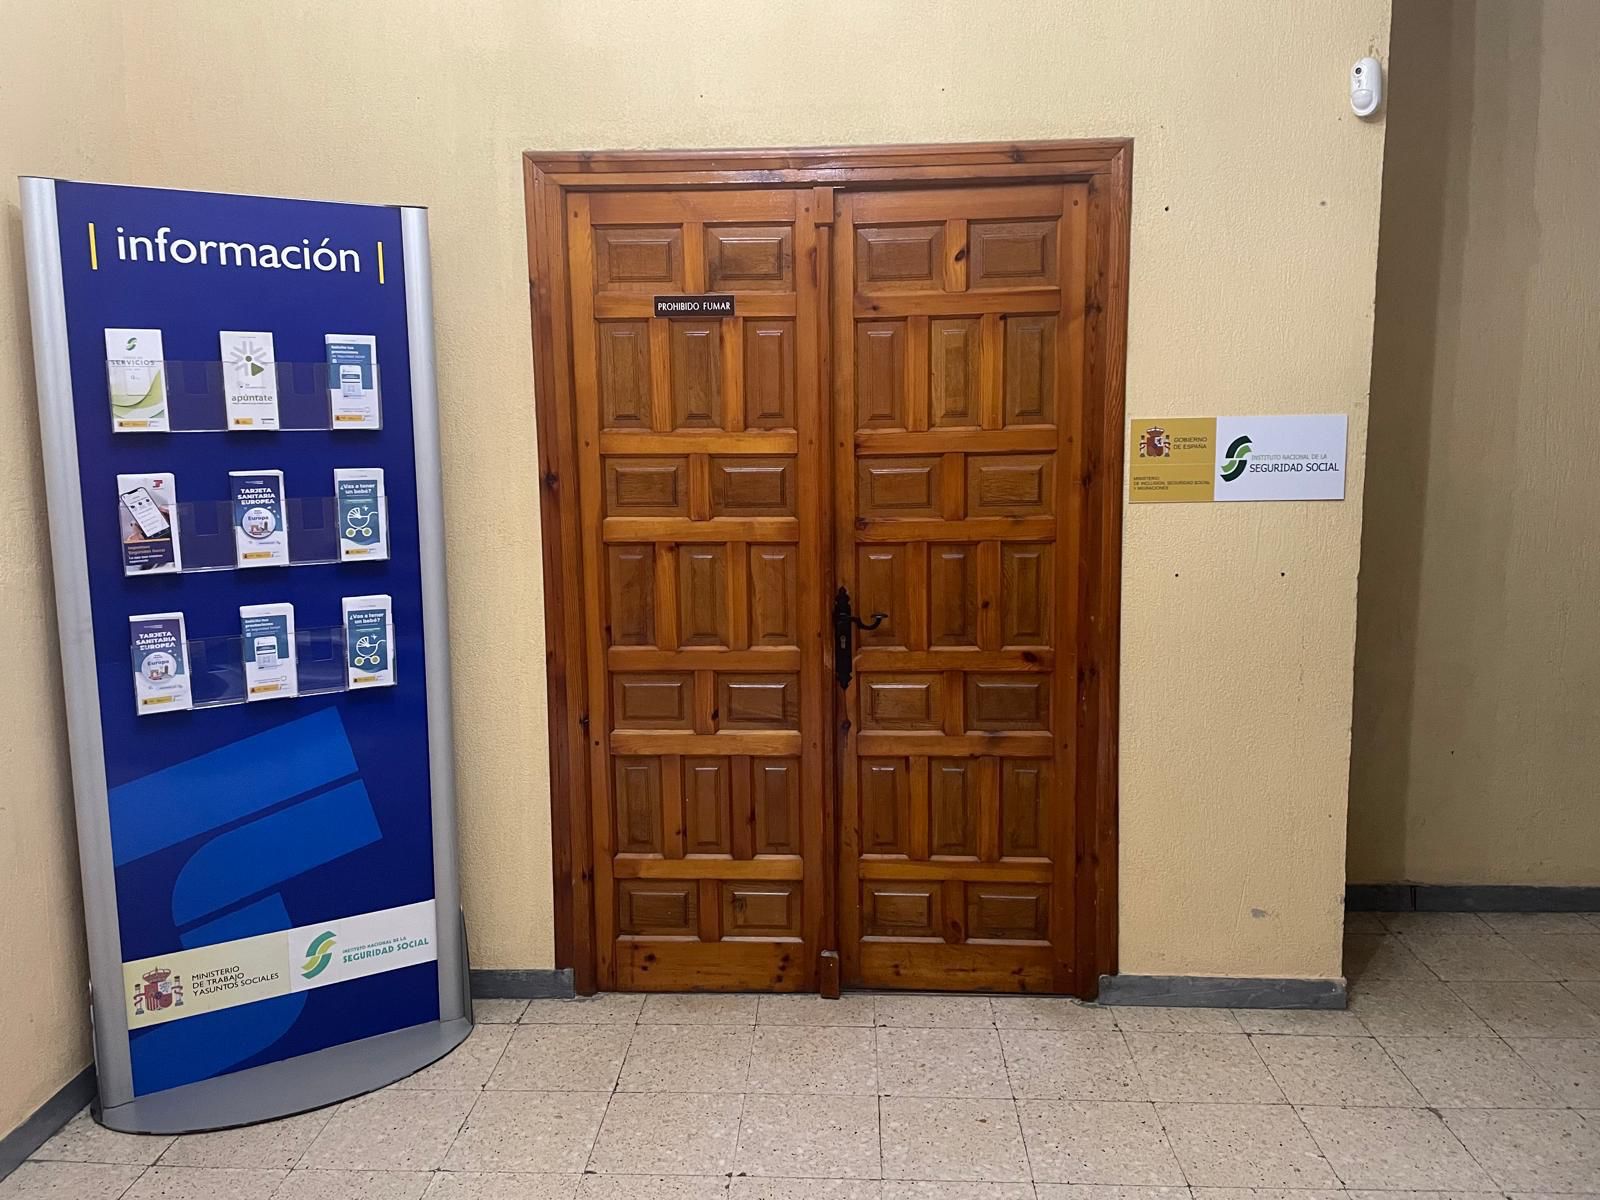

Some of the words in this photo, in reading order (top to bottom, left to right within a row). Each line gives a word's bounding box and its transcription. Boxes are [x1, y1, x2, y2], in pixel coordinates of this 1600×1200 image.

[116, 227, 360, 272] información
[658, 302, 699, 310] PROHIBIDO
[703, 302, 730, 310] FUMAR
[232, 394, 272, 402] apúntate
[1249, 463, 1303, 472] SEGURIDAD
[1306, 463, 1339, 472] SOCIAL
[136, 637, 176, 646] SANITARIA
[343, 946, 394, 963] SEGURIDAD
[397, 938, 429, 951] SOCIAL
[192, 966, 240, 981] MINISTERIO
[206, 972, 244, 986] TRABAJO
[240, 972, 279, 986] SOCIALES
